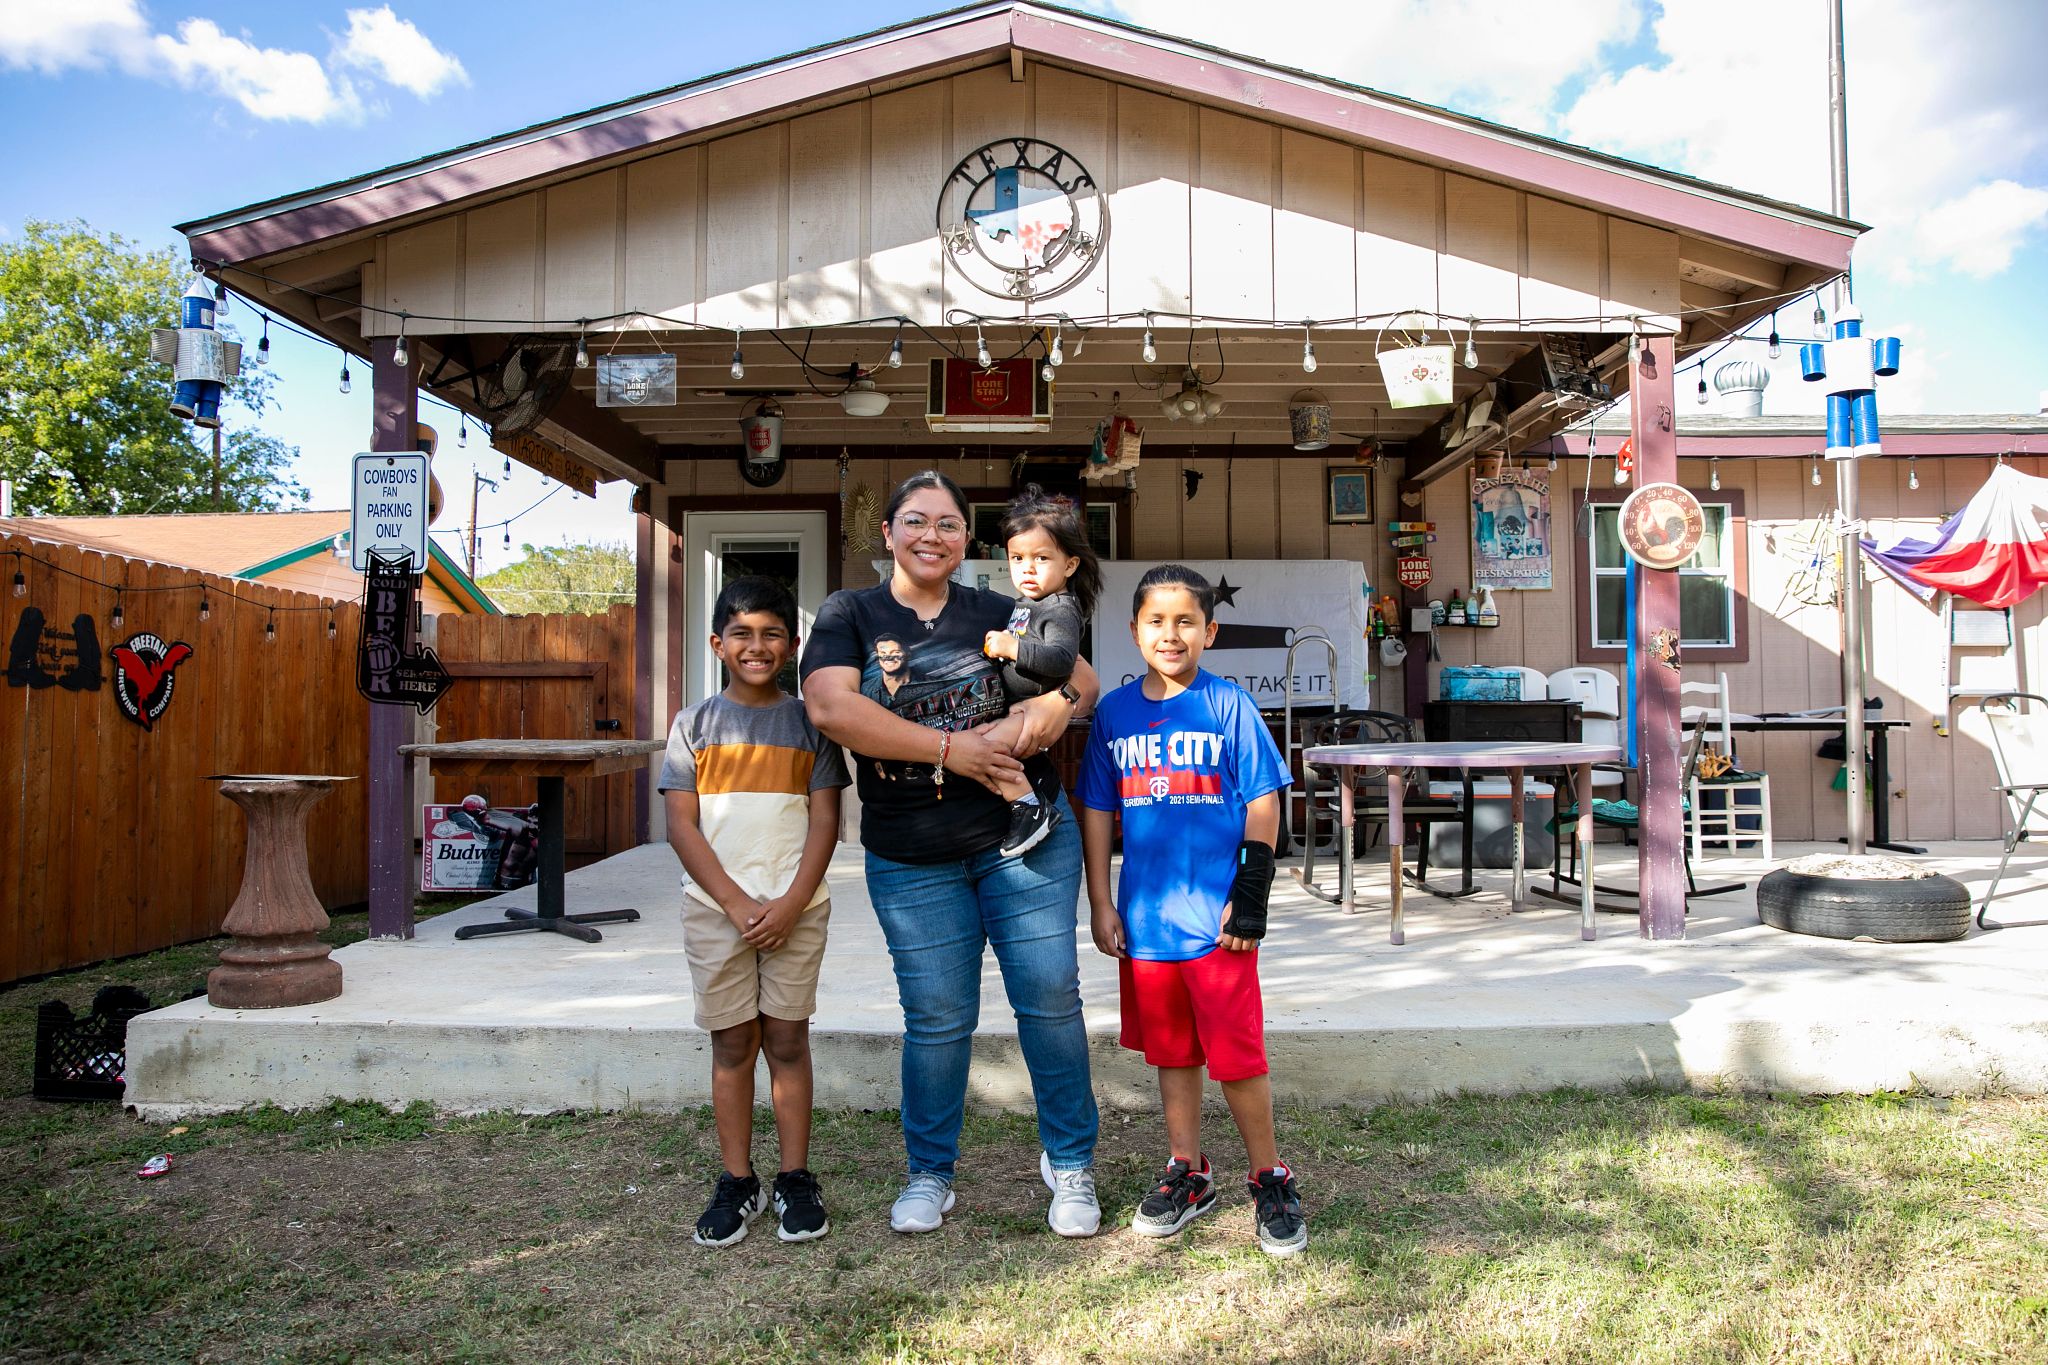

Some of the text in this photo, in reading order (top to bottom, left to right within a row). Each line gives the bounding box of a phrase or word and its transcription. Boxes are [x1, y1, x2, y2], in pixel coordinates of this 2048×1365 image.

[951, 139, 1096, 195] TEXAS
[976, 380, 1004, 388] LONE
[976, 388, 1004, 396] STAR
[364, 469, 417, 484] COWBOYS
[564, 461, 585, 488] BAR
[382, 486, 398, 498] FAN
[1646, 490, 1657, 498] 20
[1662, 488, 1673, 496] 40
[367, 503, 412, 518] PARKING
[1689, 509, 1699, 517] 80
[376, 523, 403, 538] ONLY
[1401, 560, 1430, 570] LONE
[1401, 571, 1430, 581] STAR
[1475, 569, 1551, 578] FIESTAS PATRIAS
[371, 578, 408, 589] COLD
[129, 634, 168, 660] FREETAIL
[399, 681, 437, 693] HERE
[1245, 675, 1301, 693] TAKE
[118, 668, 174, 717] BREWING COMPANY
[954, 704, 978, 718] NIGHT
[979, 700, 996, 712] TOUR
[1168, 731, 1225, 766] CITY
[1124, 795, 1225, 808] GRIDIRON 2021 SEMI-FINALS
[424, 839, 432, 887] GENUINE
